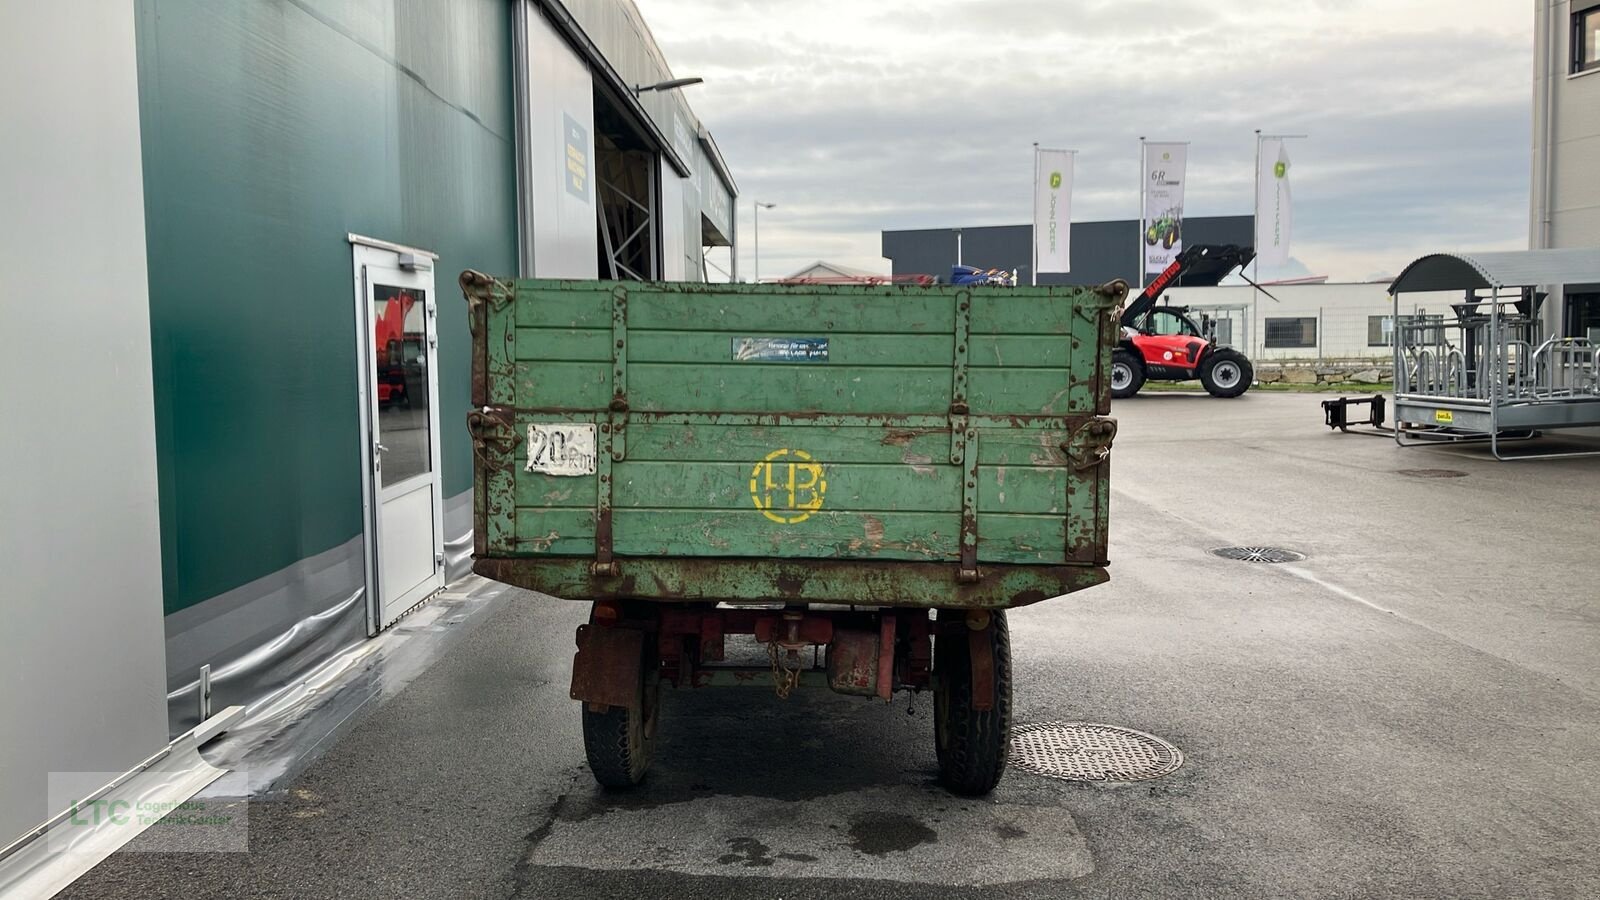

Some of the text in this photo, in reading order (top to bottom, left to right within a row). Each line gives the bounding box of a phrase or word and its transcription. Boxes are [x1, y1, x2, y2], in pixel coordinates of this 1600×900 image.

[1151, 170, 1166, 181] 6R
[1145, 260, 1182, 298] MANITOU
[528, 429, 568, 471] 20
[764, 461, 822, 510] HB
